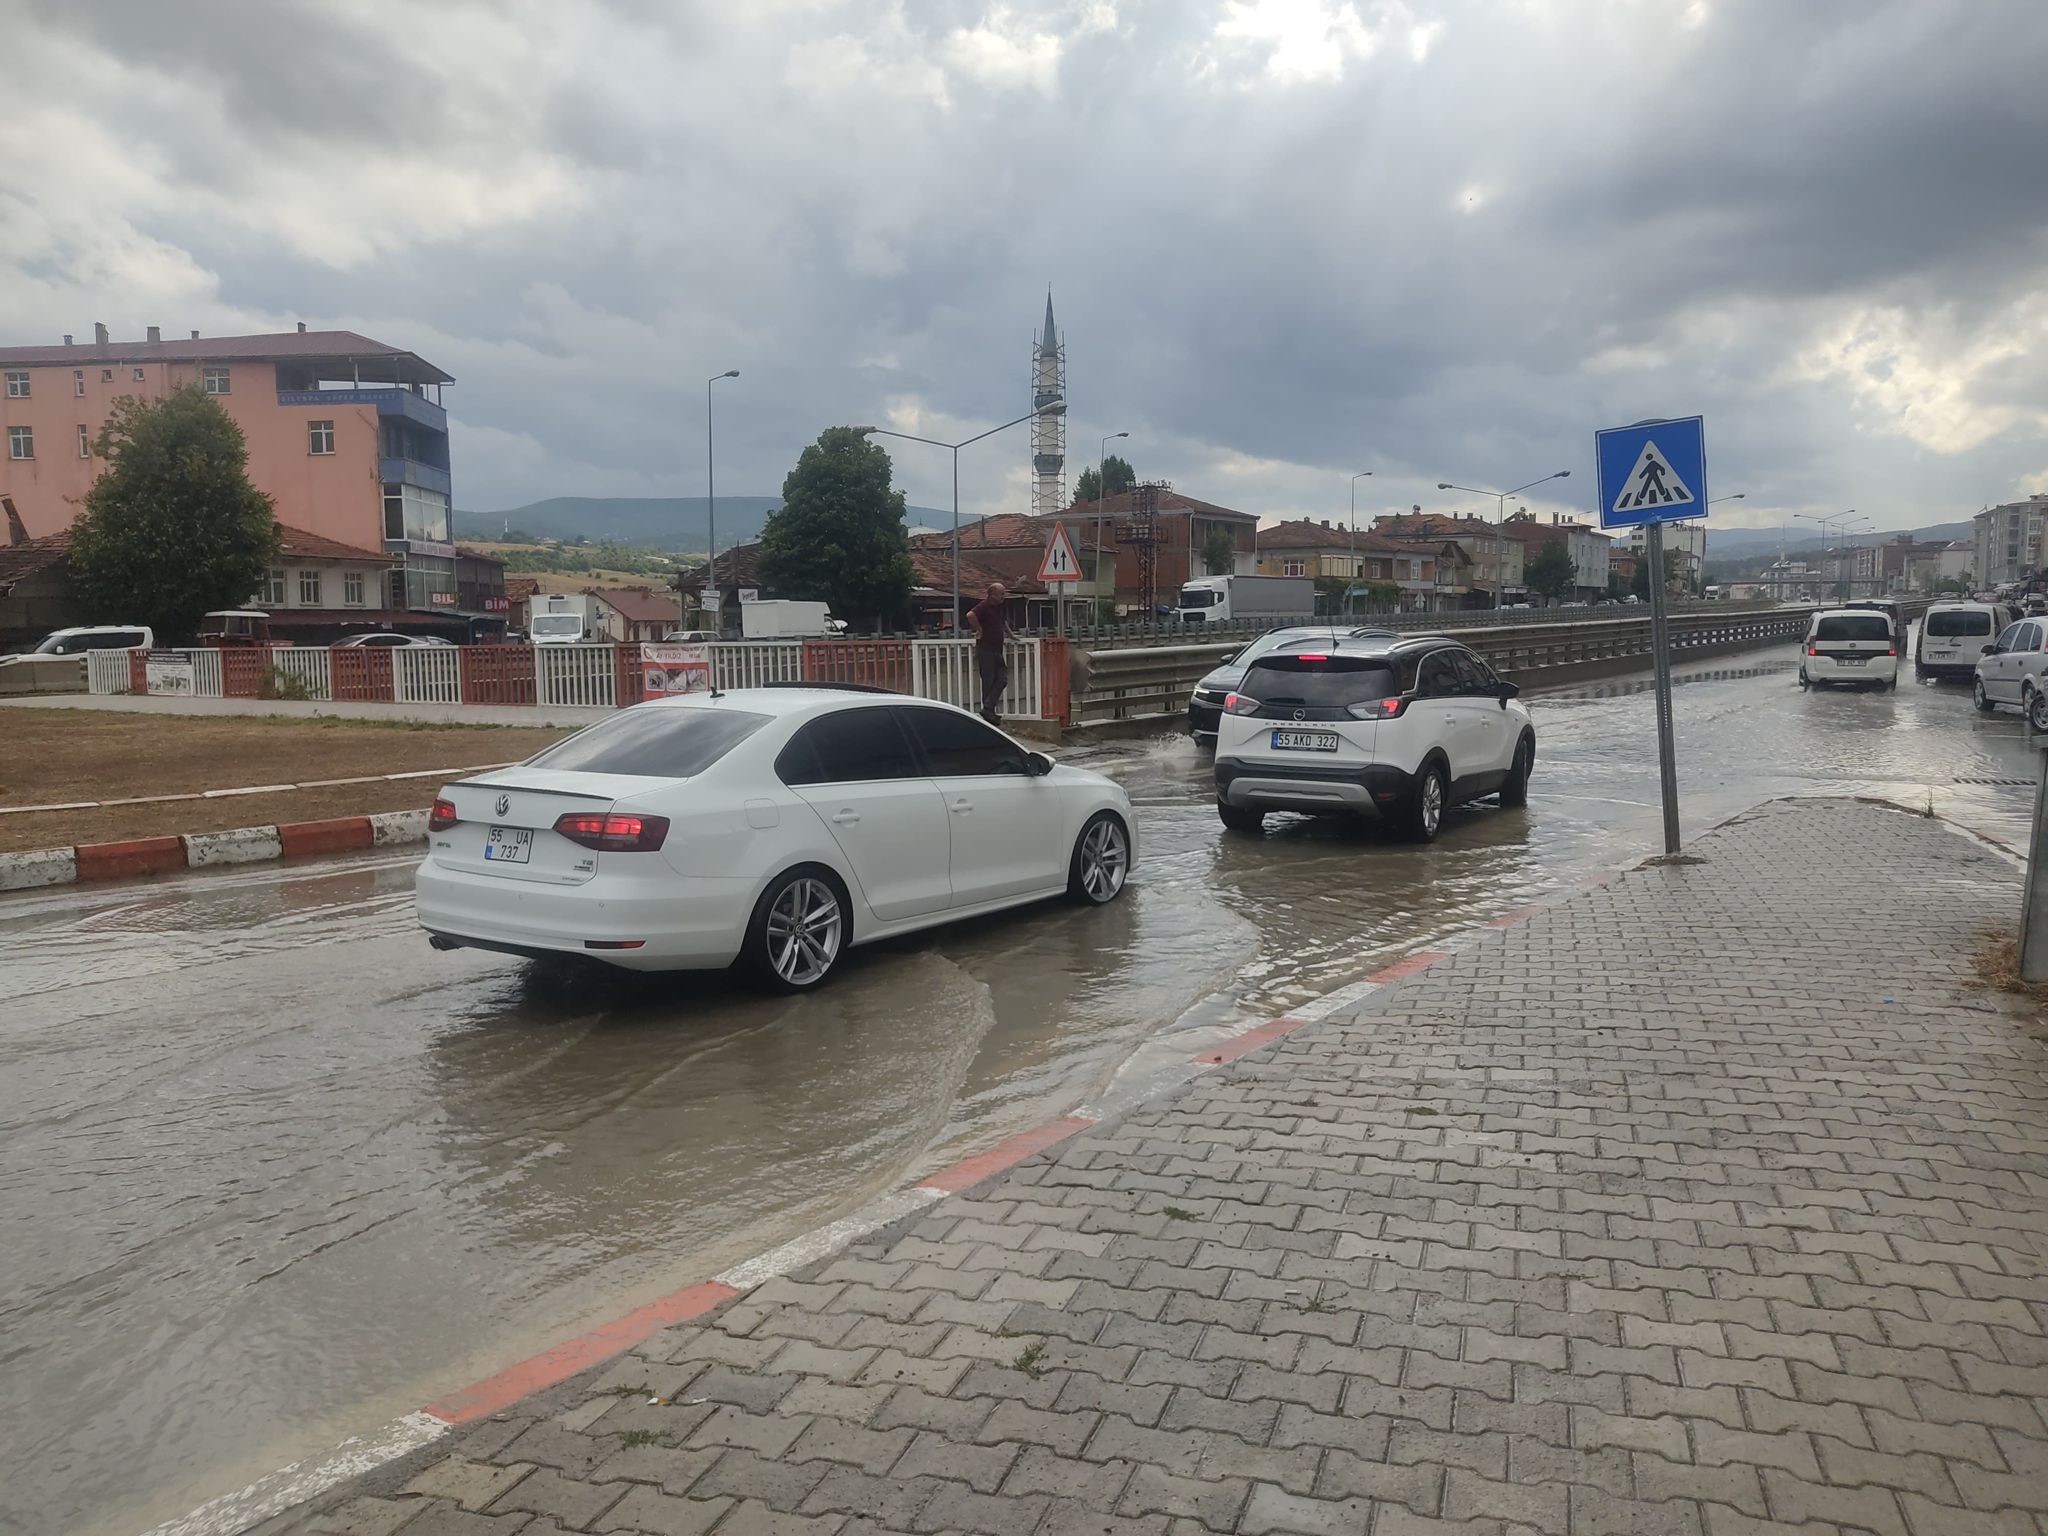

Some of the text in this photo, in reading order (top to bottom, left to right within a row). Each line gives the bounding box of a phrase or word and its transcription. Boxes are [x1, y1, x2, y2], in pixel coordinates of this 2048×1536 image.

[485, 597, 509, 610] BİM
[1278, 734, 1335, 748] 55 AKD 322
[490, 828, 529, 845] 55 UA
[500, 845, 519, 859] 737
